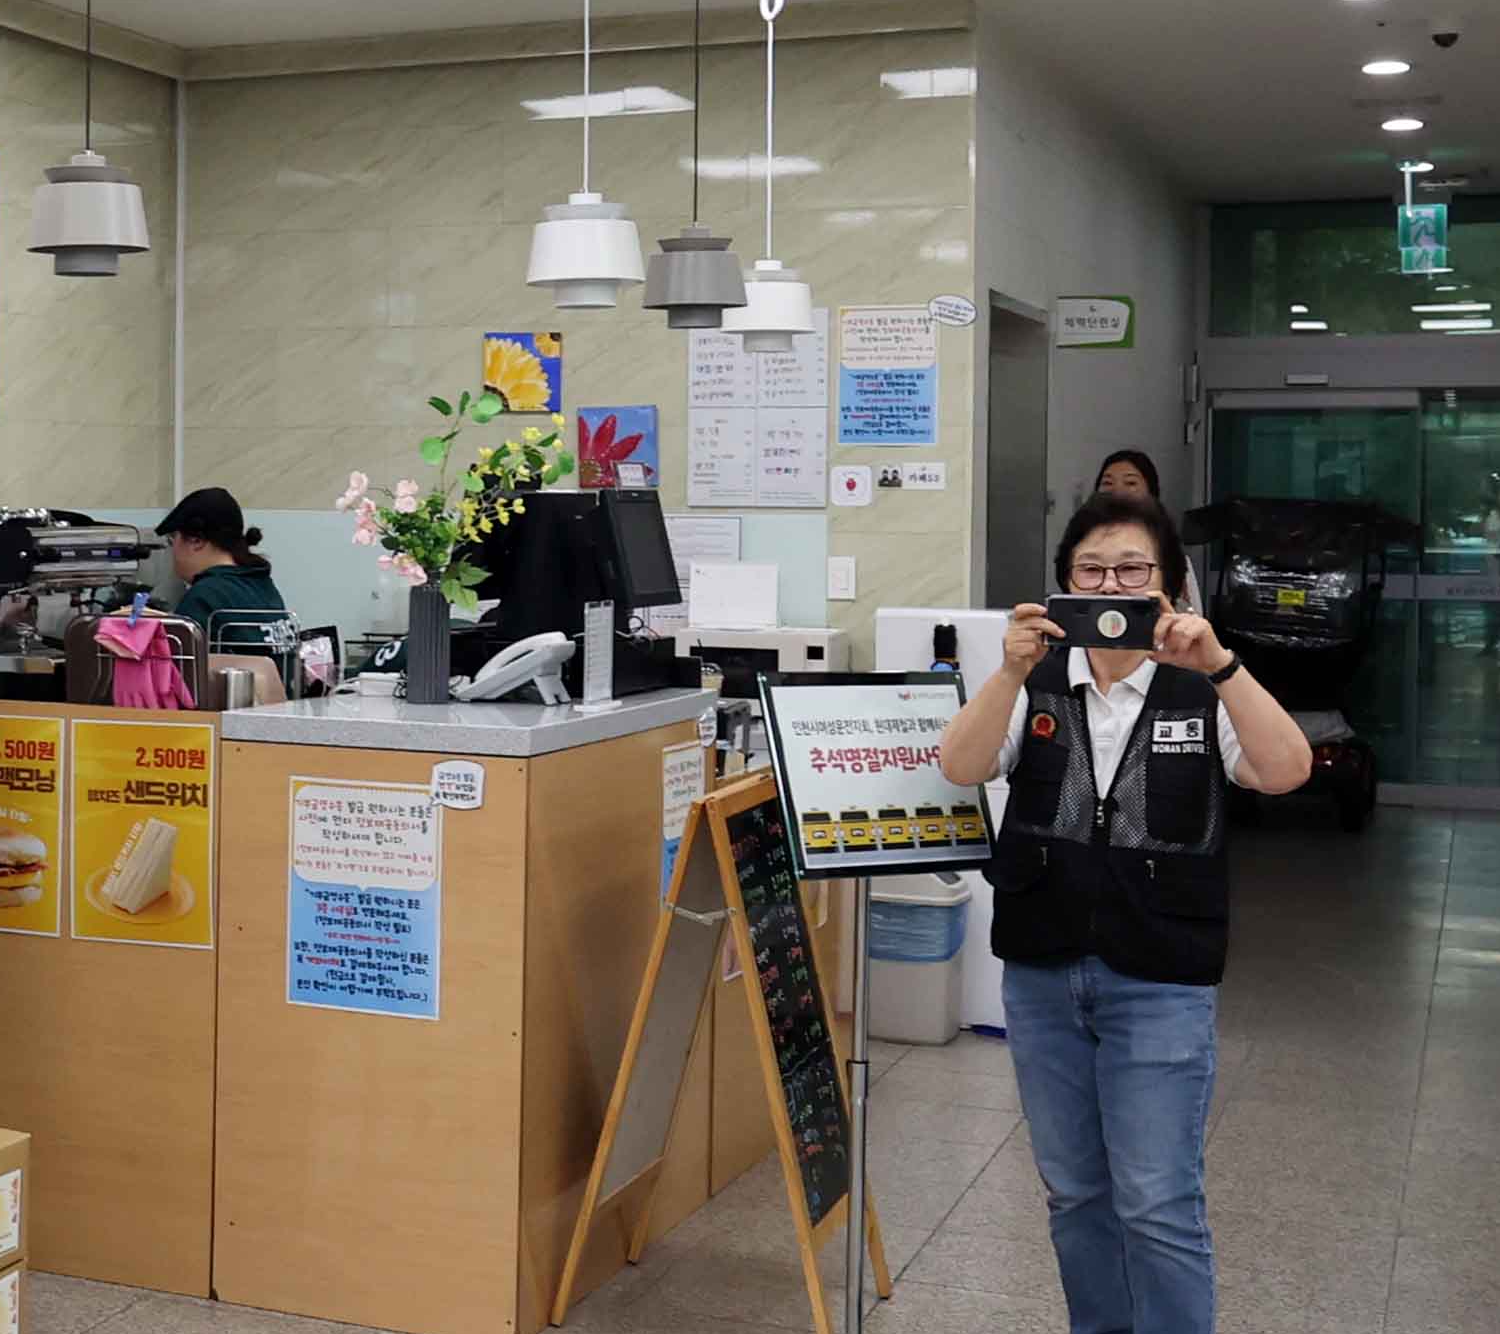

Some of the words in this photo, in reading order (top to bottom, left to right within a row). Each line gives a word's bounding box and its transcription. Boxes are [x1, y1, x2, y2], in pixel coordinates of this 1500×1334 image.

[1158, 721, 1200, 738] 교통
[136, 747, 206, 770] 2,500원
[124, 780, 208, 808] 샌드위치
